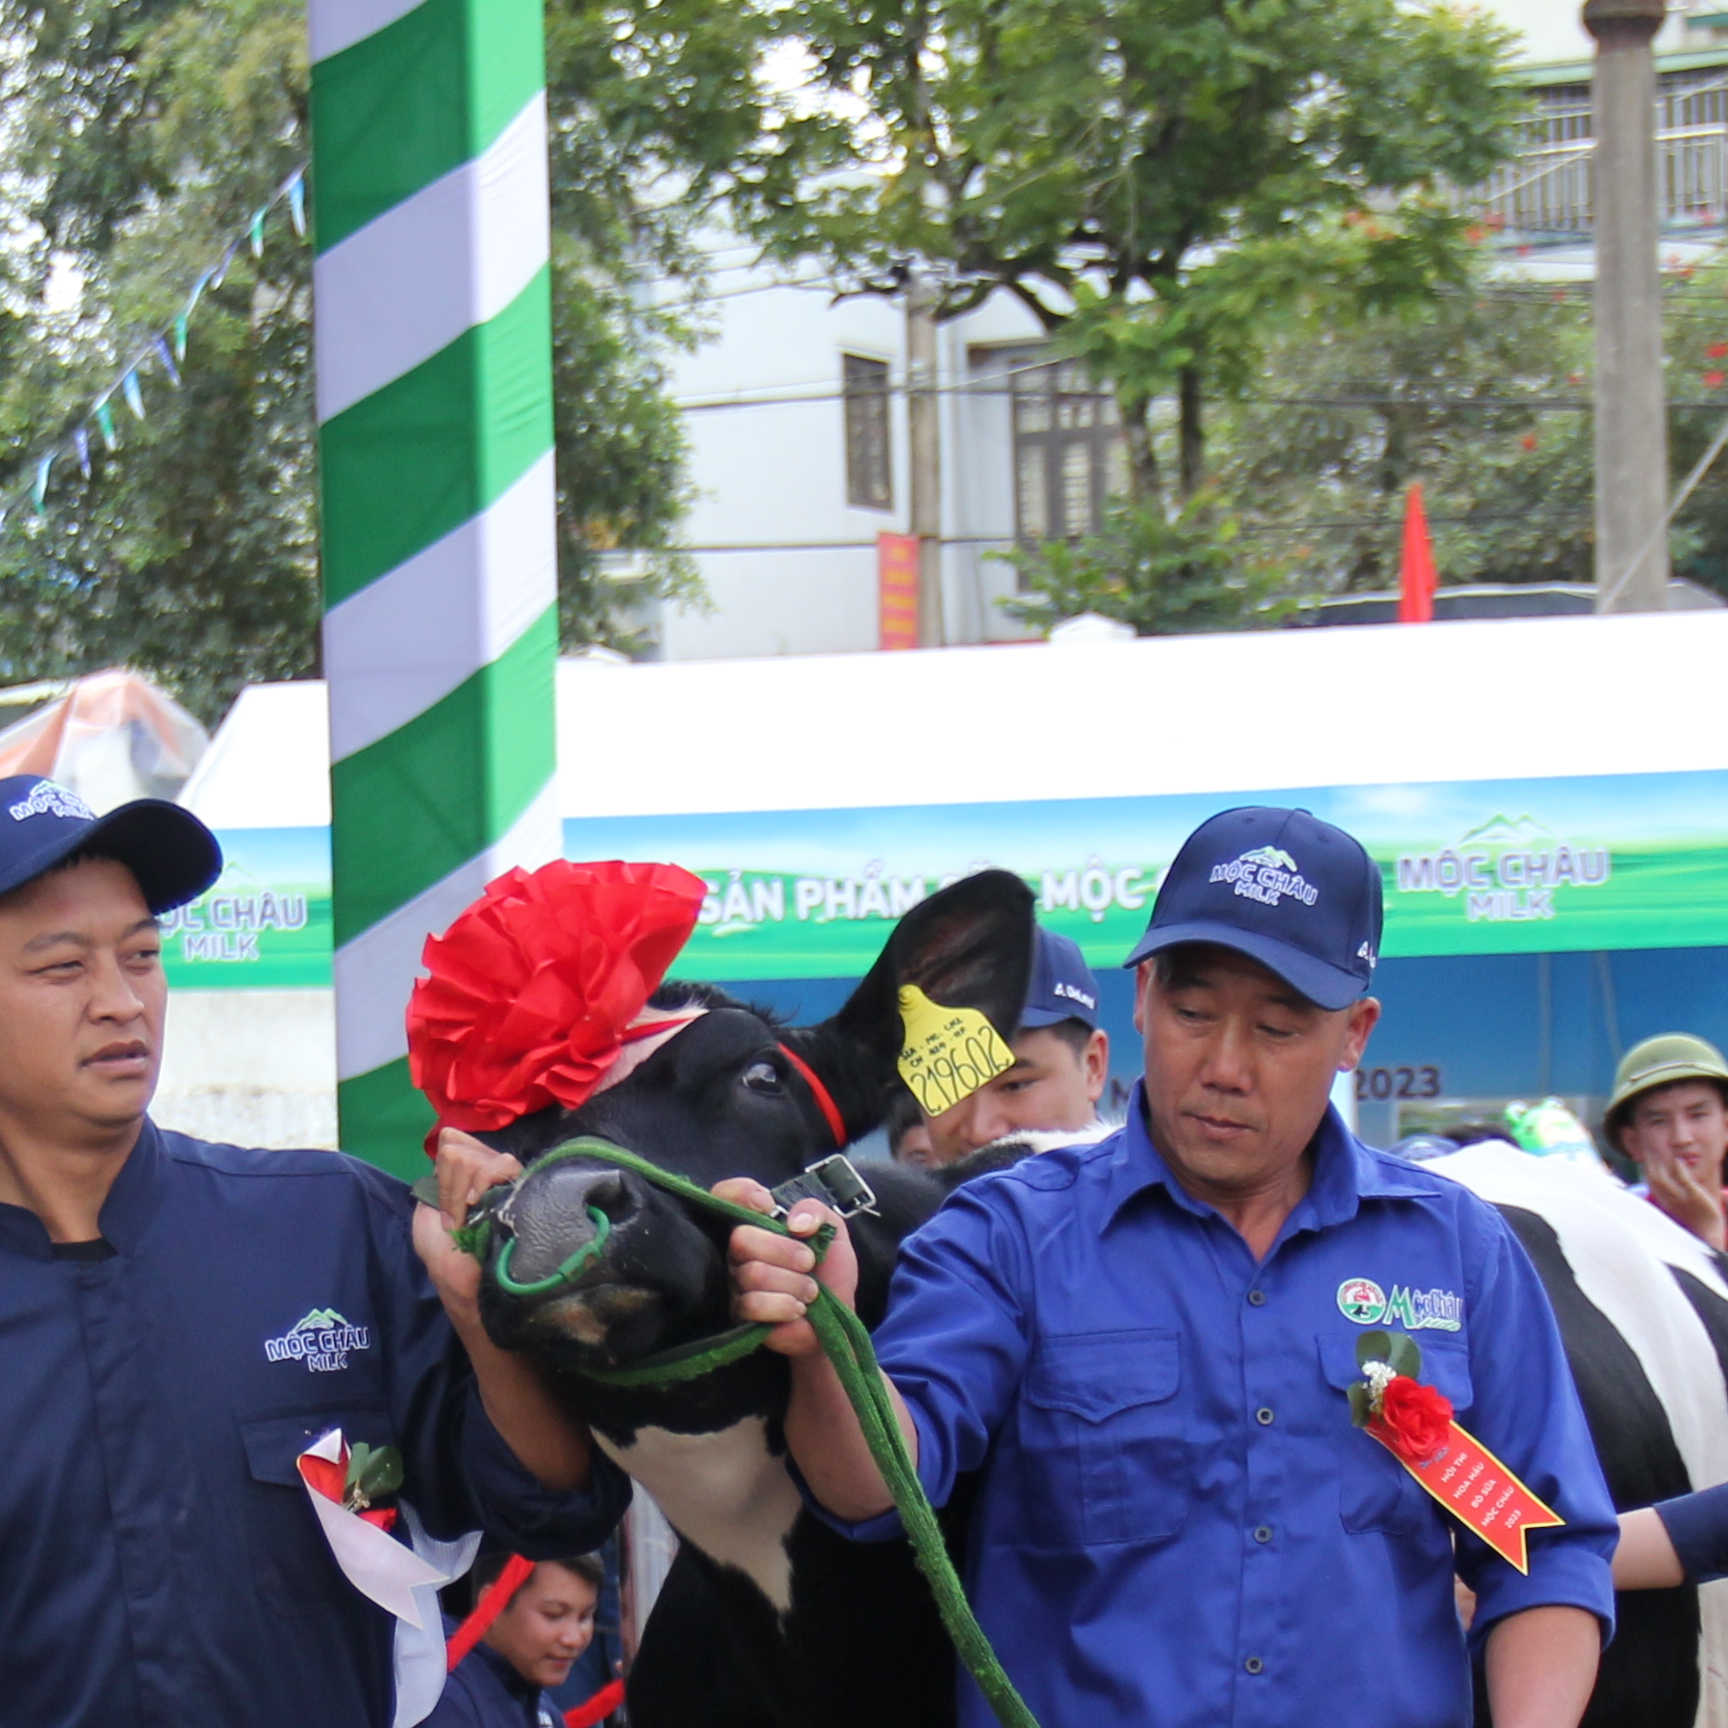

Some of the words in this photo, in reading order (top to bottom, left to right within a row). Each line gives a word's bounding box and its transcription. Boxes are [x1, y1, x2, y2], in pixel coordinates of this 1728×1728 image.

[1209, 860, 1258, 883] MỘC
[1257, 867, 1319, 906] CHÂU
[1398, 848, 1491, 897] MỘC
[1499, 845, 1610, 889] CHÂU
[698, 869, 784, 925] SẢN
[1040, 857, 1146, 923] MỘC
[1234, 882, 1281, 906] MILK
[1467, 889, 1555, 922] MILK
[212, 892, 307, 931] CHÂU
[184, 932, 260, 961] MILK
[910, 1025, 1010, 1114] 219602
[1356, 1065, 1440, 1101] 2023
[265, 1331, 318, 1362] MỘC
[319, 1324, 371, 1353] CHÂU
[307, 1351, 349, 1373] MILK
[1441, 1466, 1457, 1483] HỘI
[1453, 1452, 1468, 1467] THI
[1453, 1481, 1471, 1499] HOA
[1468, 1462, 1485, 1481] HẬU
[1470, 1494, 1484, 1509] BÒ
[1481, 1479, 1497, 1497] SỮA
[1481, 1507, 1499, 1527] MỘC
[1496, 1486, 1515, 1509] CHÂU
[1504, 1509, 1522, 1529] 2023
